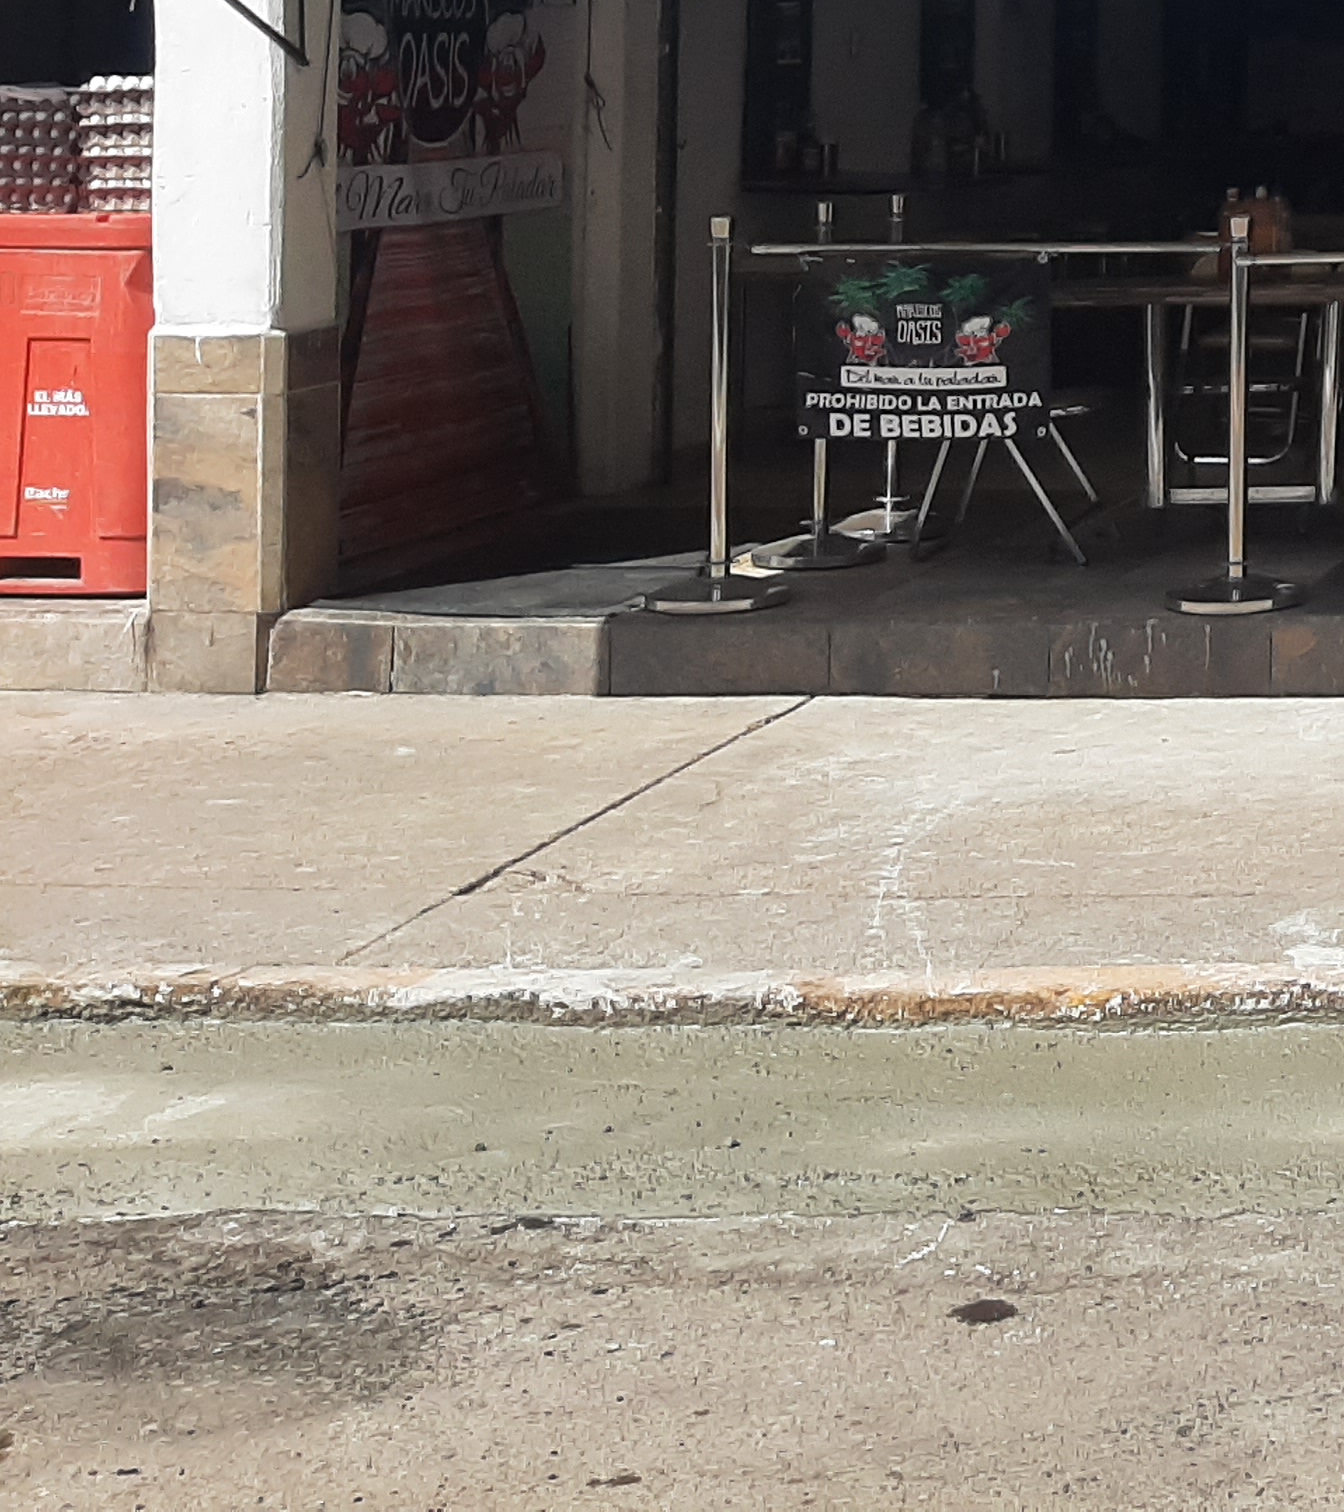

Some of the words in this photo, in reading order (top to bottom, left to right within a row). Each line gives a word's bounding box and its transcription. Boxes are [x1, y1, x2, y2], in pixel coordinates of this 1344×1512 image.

[400, 31, 470, 110] OASIS
[897, 320, 942, 345] OASIS
[805, 392, 912, 410] PROHIBIDO
[917, 395, 942, 410] LA
[946, 392, 1042, 410] ENTRADA
[829, 413, 872, 437] DE
[879, 412, 1018, 438] BEBIDAS
